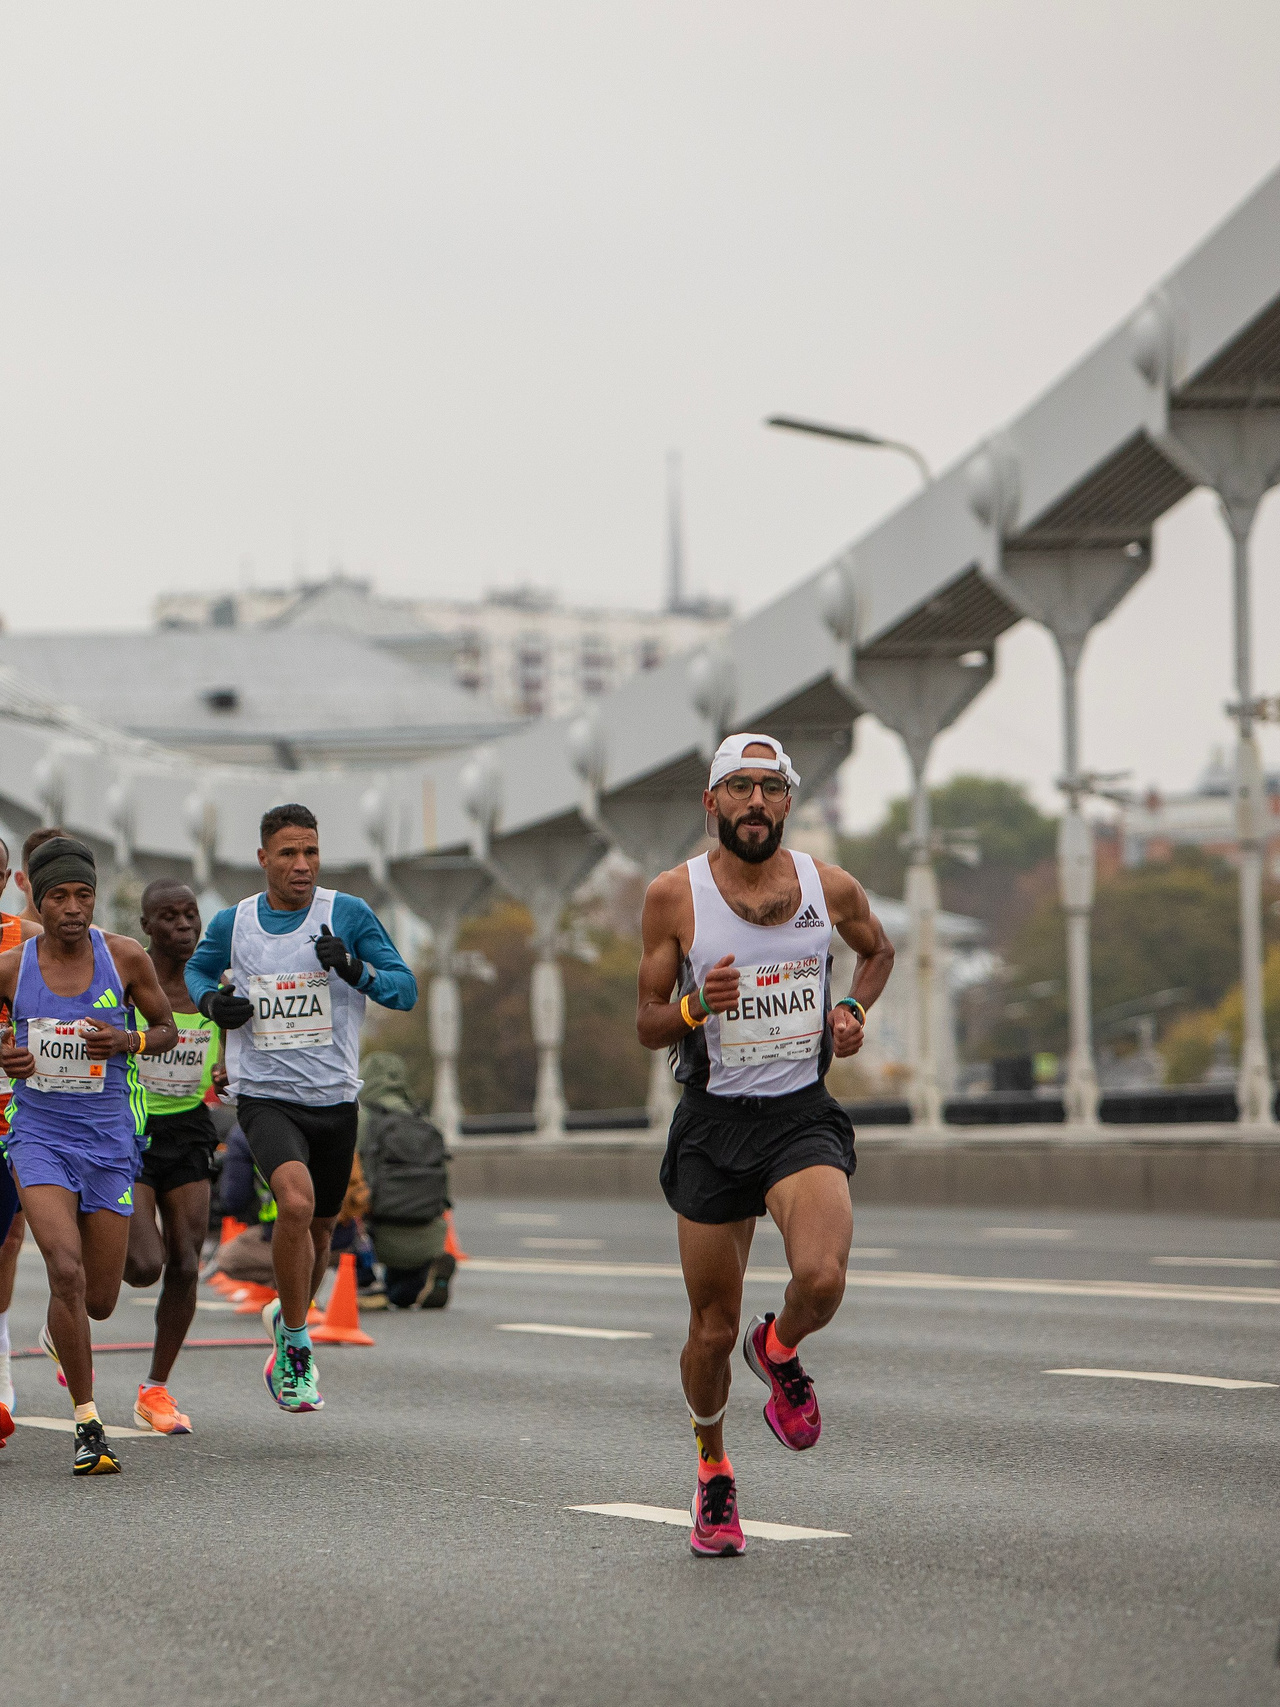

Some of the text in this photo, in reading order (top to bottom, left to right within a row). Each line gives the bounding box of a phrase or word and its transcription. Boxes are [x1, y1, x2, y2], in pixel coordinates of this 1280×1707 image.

[794, 918, 825, 928] adidas
[782, 960, 801, 971] 42,2
[258, 994, 324, 1020] DAZZA
[726, 987, 816, 1022] BENNAR
[285, 1021, 295, 1029] 20
[768, 1026, 781, 1036] 22
[39, 1039, 91, 1060] KORIR
[59, 1065, 68, 1073] 21
